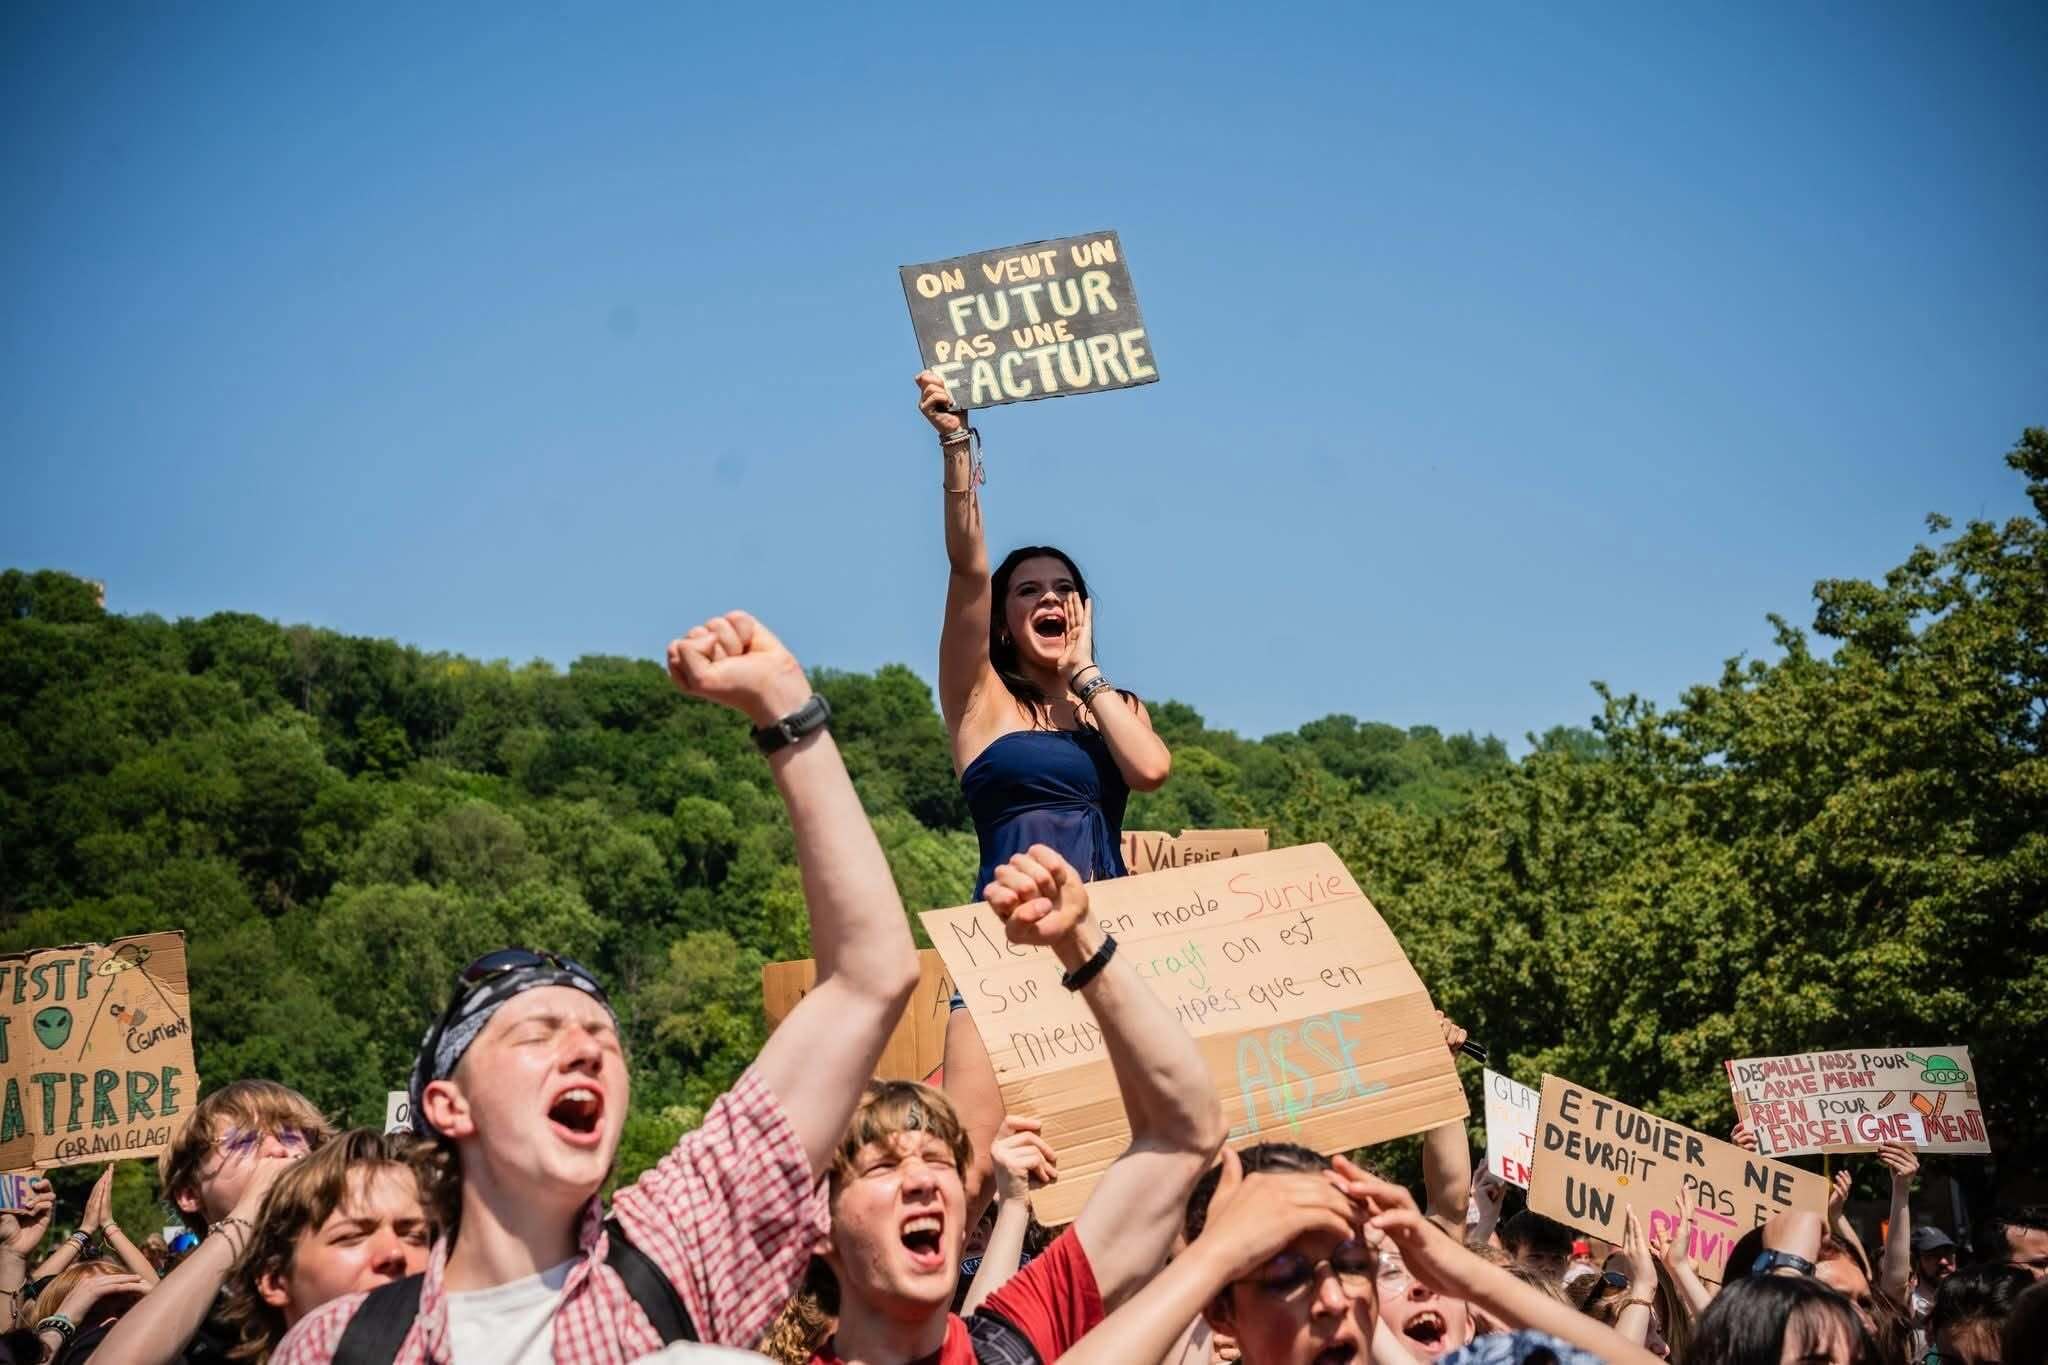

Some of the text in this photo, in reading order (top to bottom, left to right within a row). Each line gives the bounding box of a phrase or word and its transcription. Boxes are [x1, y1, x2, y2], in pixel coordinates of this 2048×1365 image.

[917, 239, 1117, 298] ON VEUT UN
[948, 270, 1118, 337] FUTUR
[931, 328, 1156, 404] FACTURE
[935, 319, 1075, 363] PAS UNE
[1099, 914, 1134, 935] en
[1152, 889, 1219, 927] mode
[1228, 873, 1357, 919] Survie
[979, 977, 1039, 1013] Sur
[1222, 935, 1261, 963] on
[1279, 911, 1314, 946] est
[1248, 975, 1304, 1013] que
[1320, 964, 1362, 988] en
[1737, 1065, 1765, 1084] DES
[1861, 1054, 1909, 1070] POUR
[30, 1066, 182, 1136] TERRE
[1818, 1097, 1872, 1119] POUR
[1565, 1176, 1615, 1227] UN
[1684, 1173, 1735, 1216] PAS
[1744, 1160, 1794, 1207] NE
